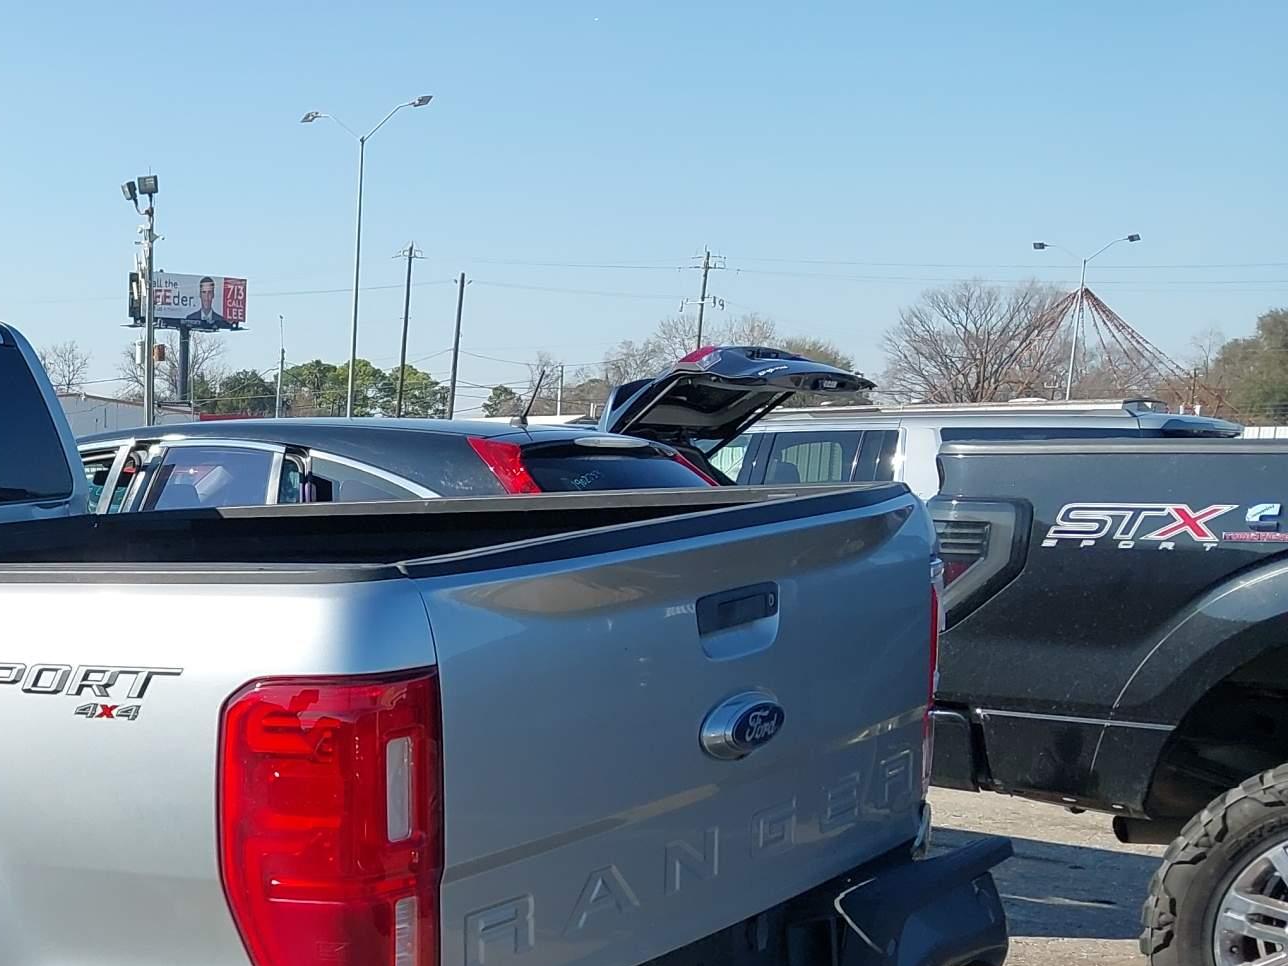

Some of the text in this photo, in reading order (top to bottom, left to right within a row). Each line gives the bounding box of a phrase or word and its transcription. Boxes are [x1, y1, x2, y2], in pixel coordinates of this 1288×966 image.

[164, 279, 178, 288] the
[227, 285, 245, 299] 713
[227, 299, 244, 308] CALL
[226, 307, 244, 320] LEE
[1046, 502, 1241, 542] STX
[1040, 538, 1218, 552] SPORT
[745, 709, 777, 742] Ford
